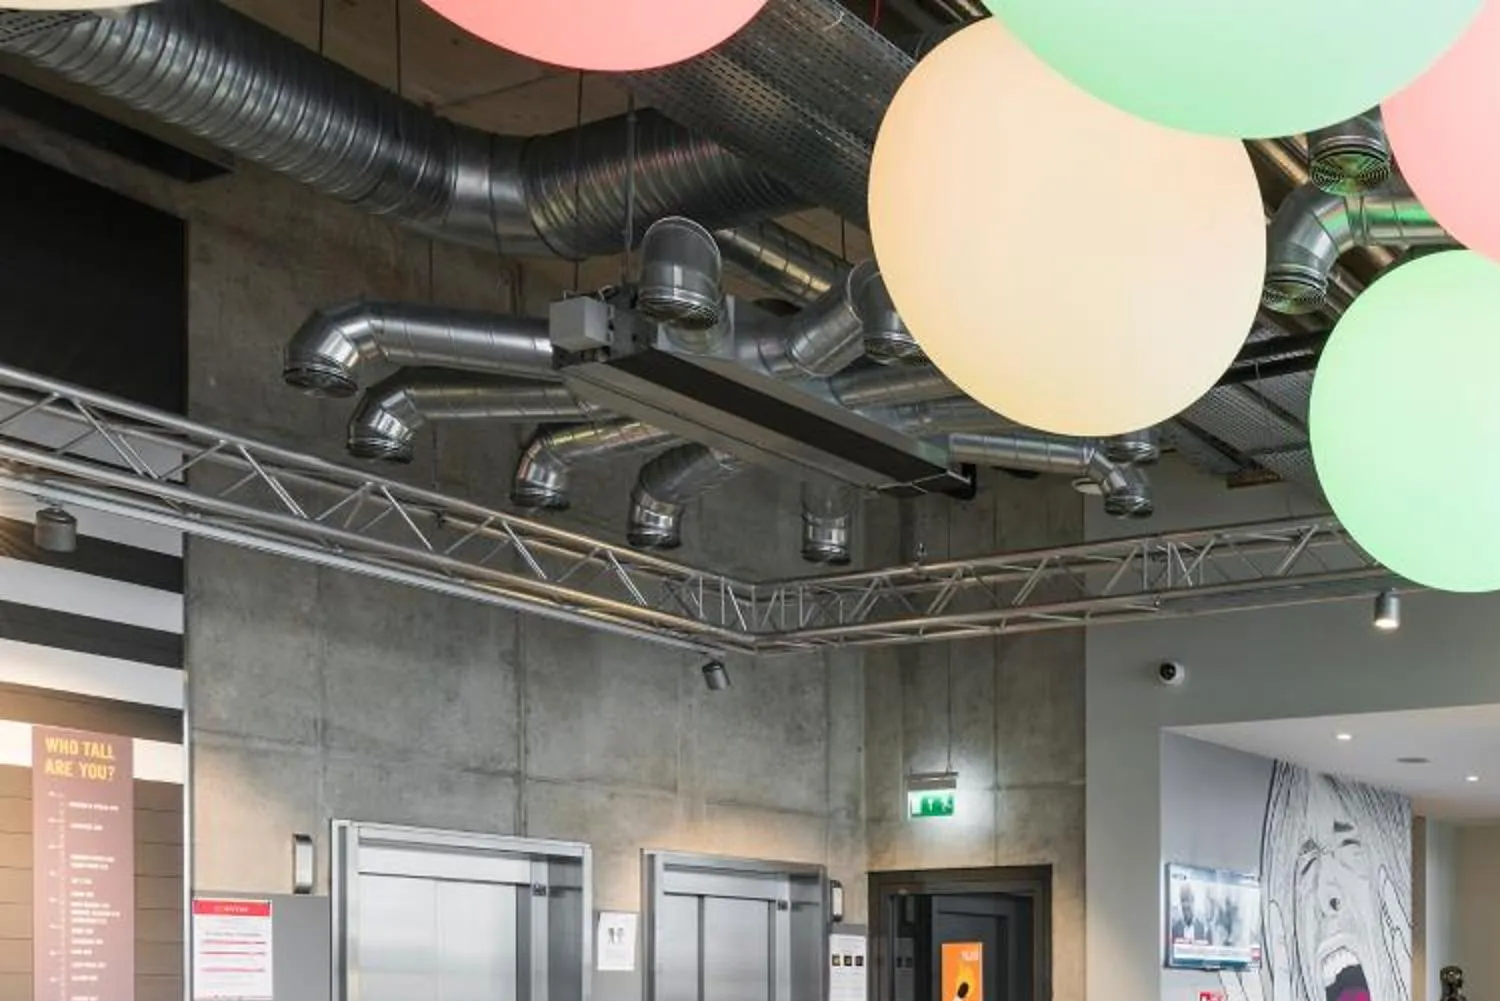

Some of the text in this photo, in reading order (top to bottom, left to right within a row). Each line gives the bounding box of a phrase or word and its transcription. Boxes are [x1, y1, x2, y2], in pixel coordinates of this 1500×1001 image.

[44, 737, 113, 759] WHO TALL
[45, 759, 115, 780] ARE YOU?
